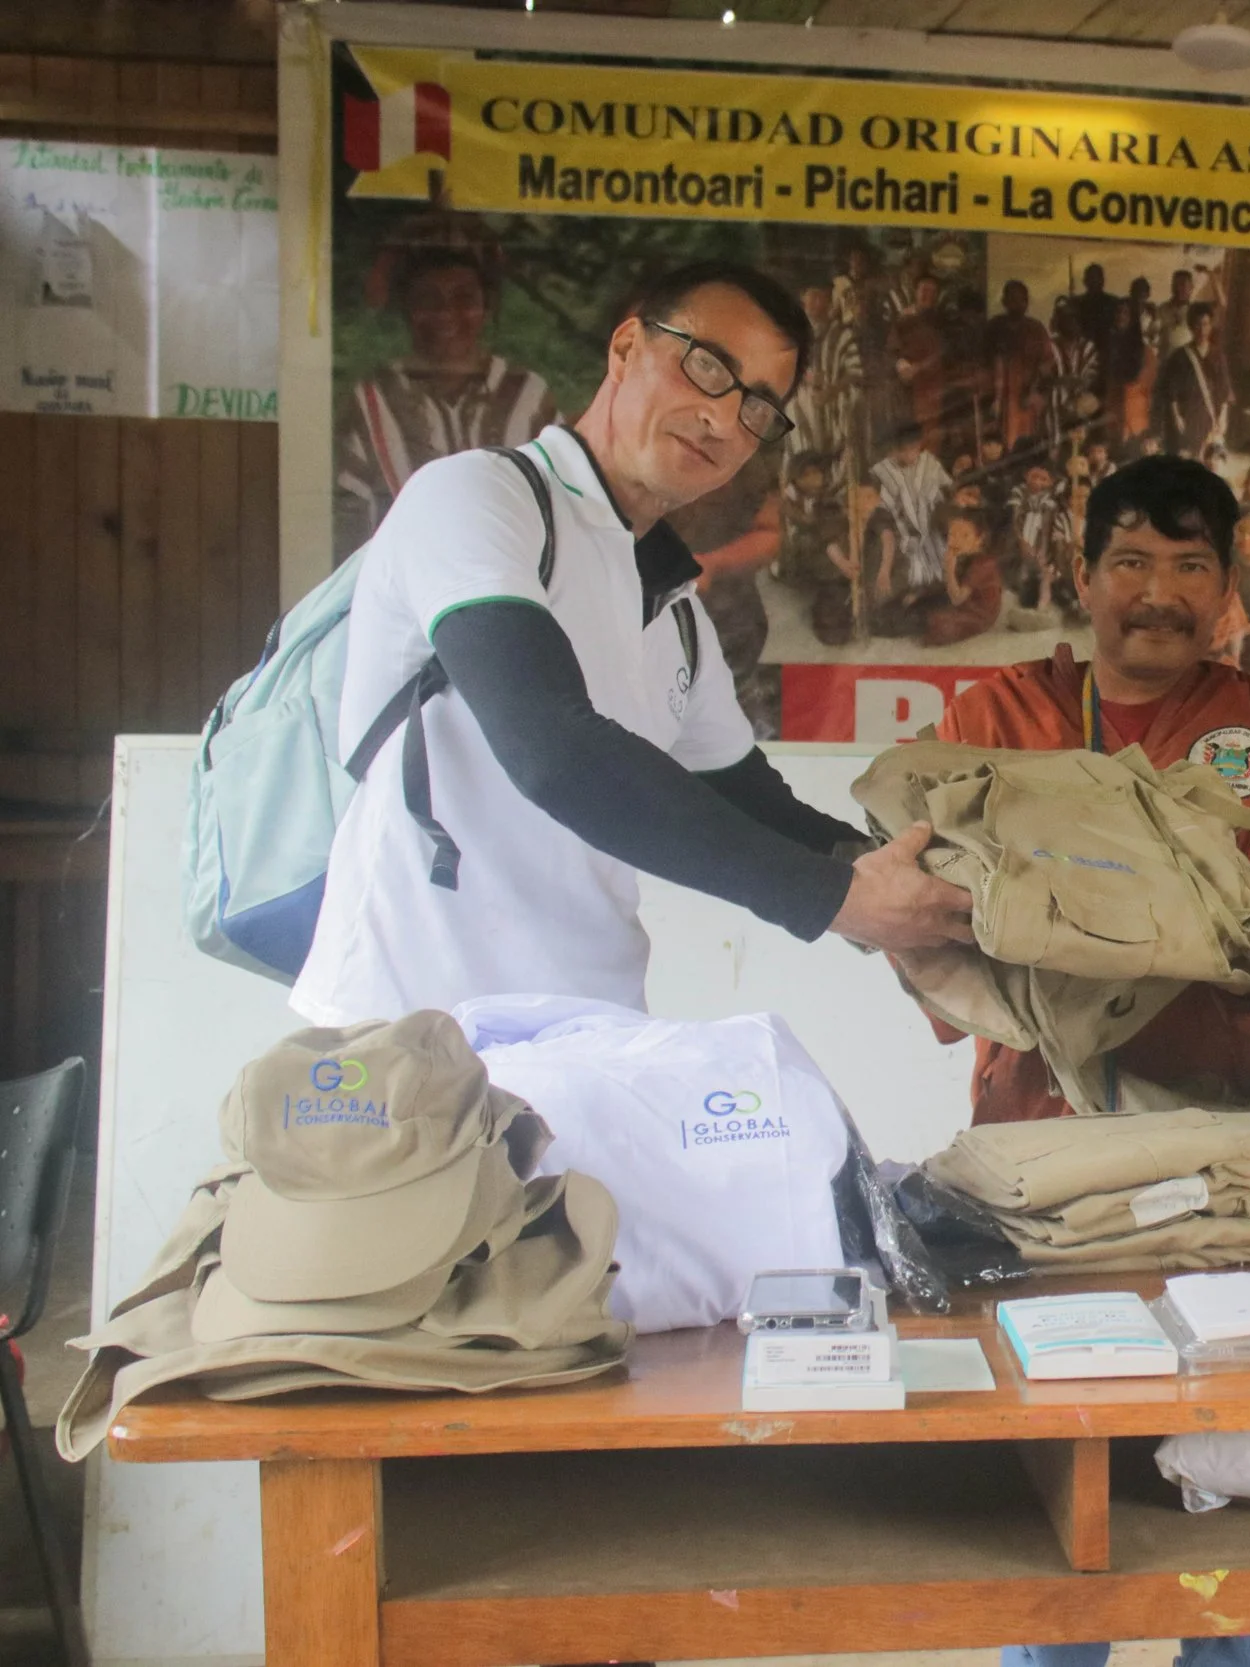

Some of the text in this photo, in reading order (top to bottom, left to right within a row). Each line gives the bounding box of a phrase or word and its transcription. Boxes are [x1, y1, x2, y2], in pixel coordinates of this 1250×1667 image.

[481, 96, 843, 147] COMUNIDAD
[860, 114, 1199, 169] ORIGINARIA
[519, 153, 764, 208] Marontoari
[804, 164, 958, 215] Pichari
[1002, 175, 1053, 219] La
[296, 1098, 387, 1117] GLOBAL
[295, 1112, 389, 1129] CONSERVATION
[693, 1116, 789, 1136] GLOBAL
[694, 1129, 791, 1146] CONSERVATION
